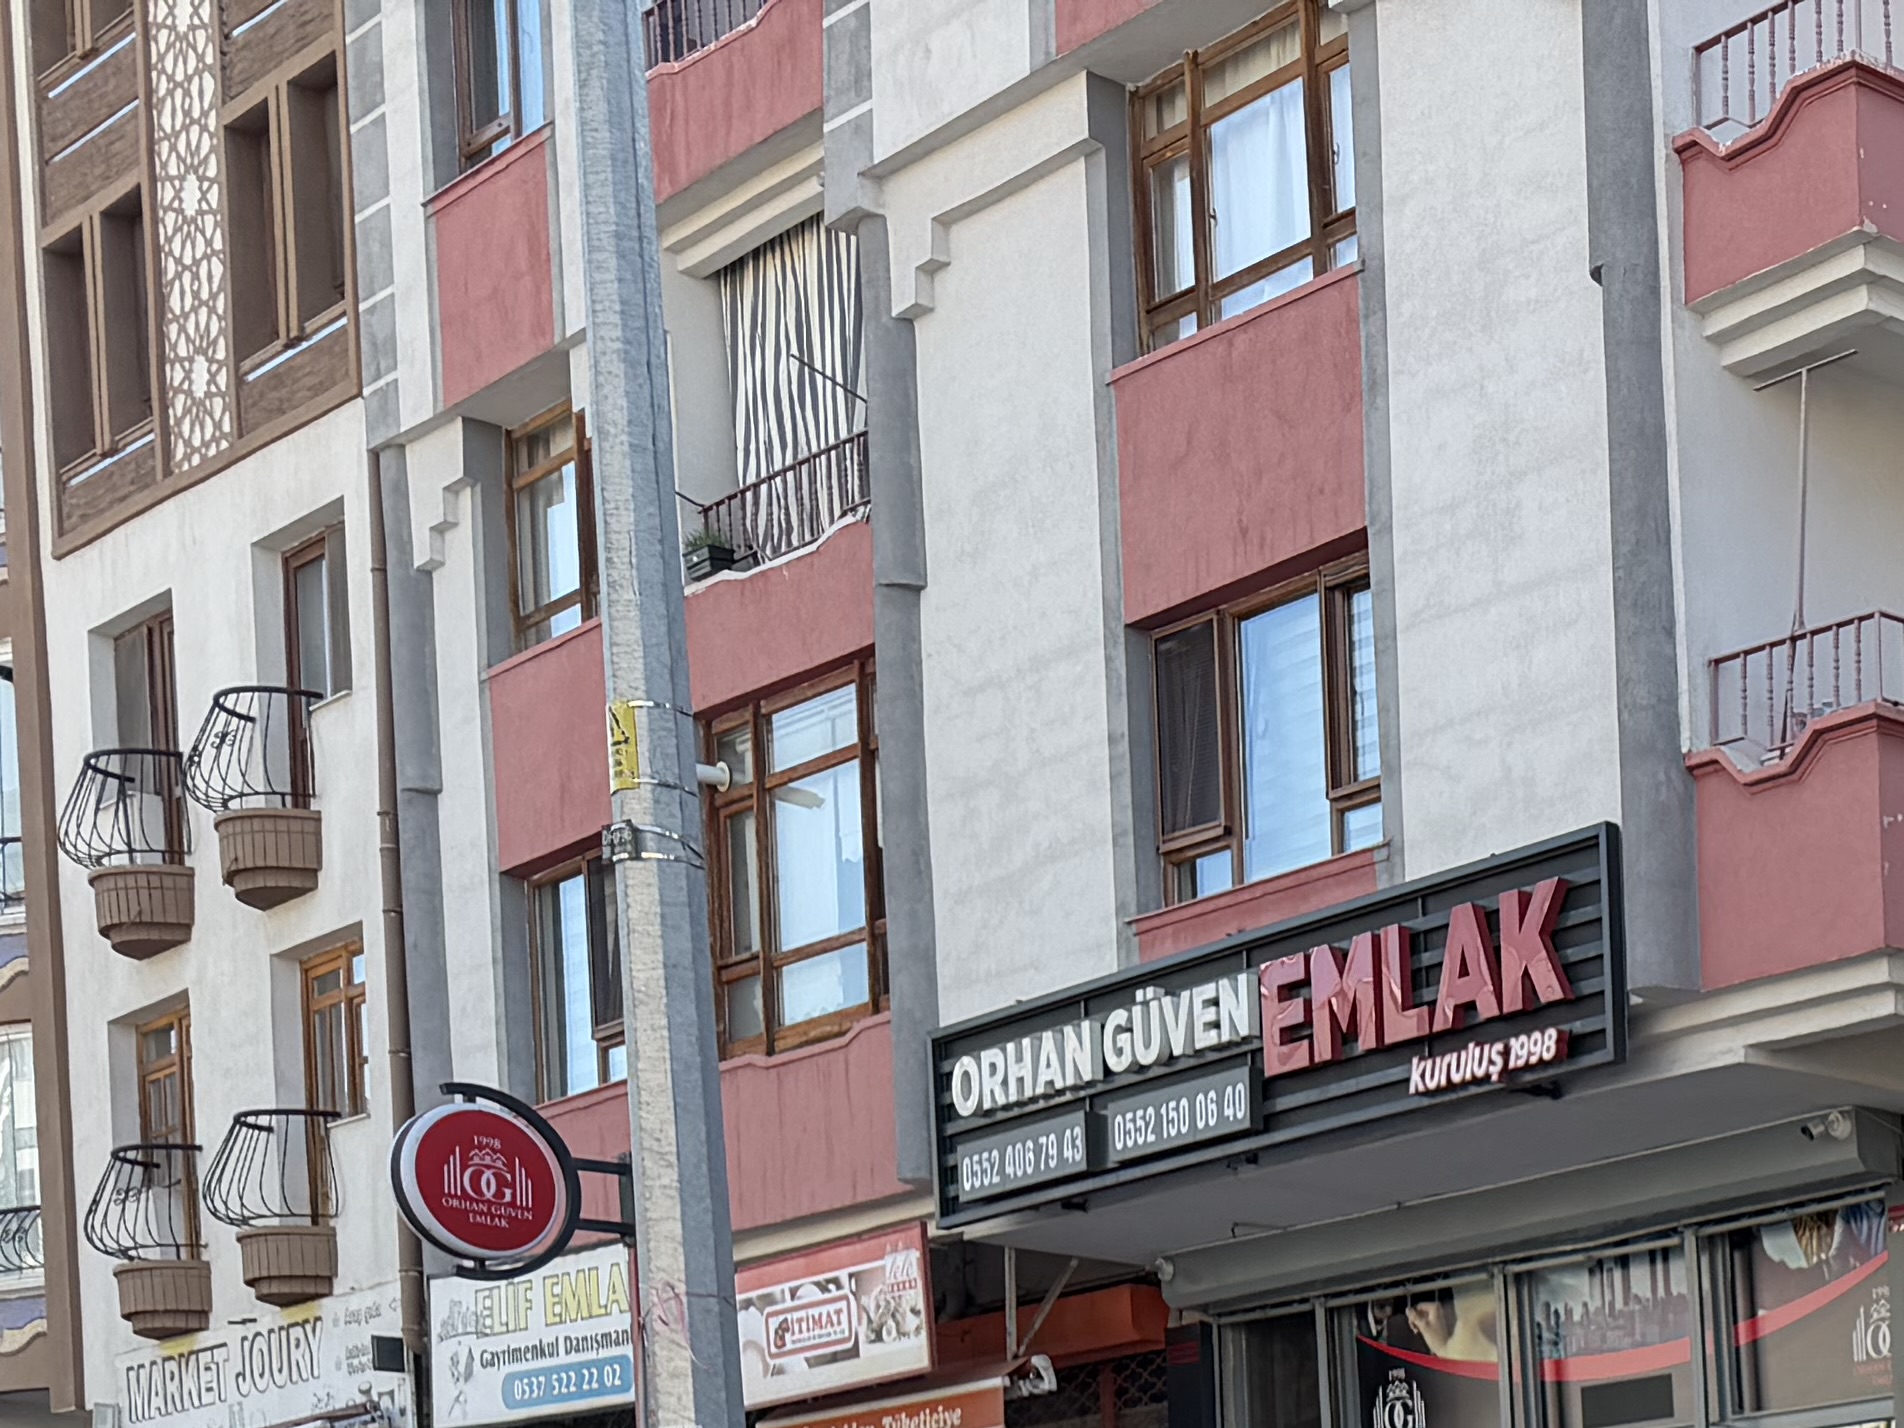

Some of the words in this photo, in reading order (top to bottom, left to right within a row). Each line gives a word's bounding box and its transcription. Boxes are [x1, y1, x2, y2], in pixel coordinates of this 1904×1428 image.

[1260, 876, 1576, 1078] EMLAK
[951, 1019, 1103, 1118] ORHAN
[1103, 973, 1259, 1074] GÜVEN
[1408, 1036, 1504, 1095] kuruluş
[1508, 1027, 1563, 1072] 1998
[473, 1135, 502, 1149] 1998
[1113, 1106, 1156, 1151] 0552
[1160, 1097, 1190, 1140] 150
[1195, 1089, 1218, 1131] 06
[1222, 1081, 1246, 1123] 40
[962, 1148, 1000, 1192] 0552
[1004, 1139, 1035, 1181] 406
[1038, 1134, 1059, 1173] 79
[1062, 1126, 1084, 1165] 43
[442, 1196, 488, 1213] ORHAN
[469, 1213, 509, 1228] EMLAK
[475, 1278, 533, 1339] ELİF
[543, 1262, 630, 1327] EMLA
[127, 1343, 229, 1424] MARKET
[236, 1317, 323, 1397] JOURY
[480, 1336, 560, 1371] Gayrimenkul
[564, 1328, 630, 1357] Danışman
[514, 1376, 545, 1400] 0537
[552, 1371, 577, 1395] 522
[582, 1367, 598, 1391] 22
[604, 1364, 622, 1387] 02
